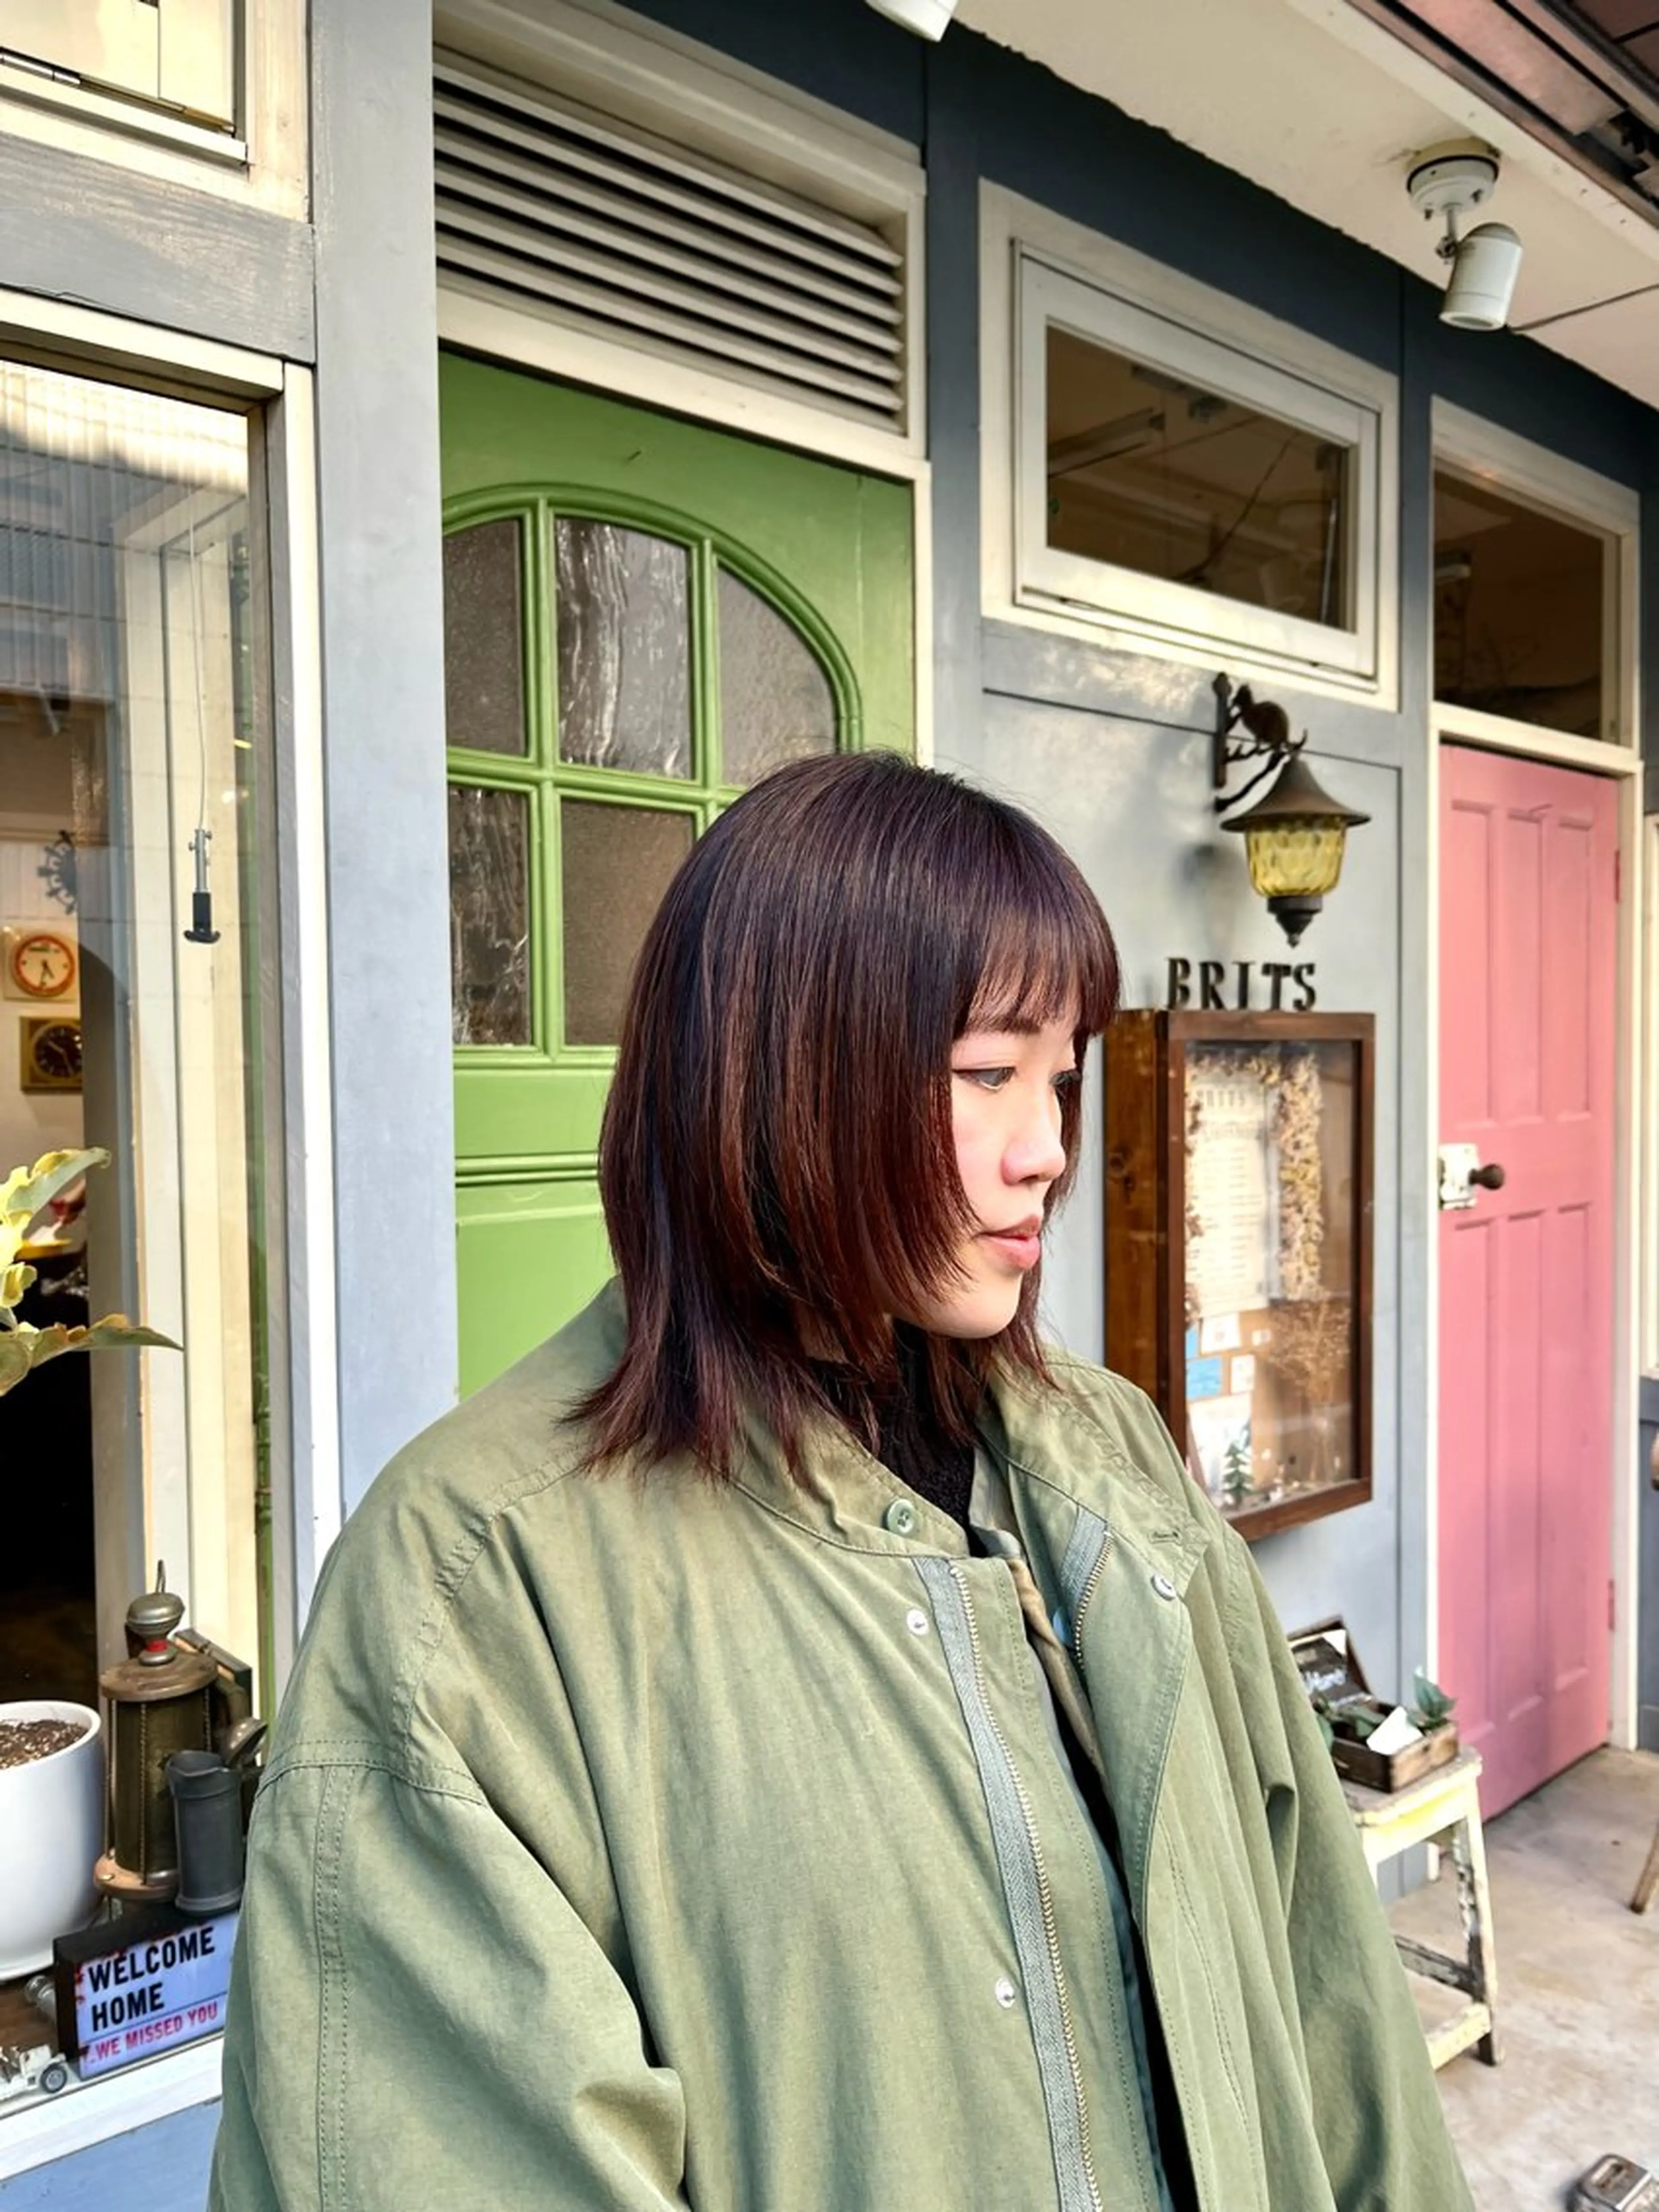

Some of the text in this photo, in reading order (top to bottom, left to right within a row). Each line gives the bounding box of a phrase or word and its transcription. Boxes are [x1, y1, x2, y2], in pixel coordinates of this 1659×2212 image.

[1165, 957, 1316, 1011] BRITS
[88, 1926, 215, 1993] WELCOME
[92, 1982, 165, 2031] HOME
[125, 2015, 183, 2049] MISSED
[187, 2001, 218, 2026] YOU
